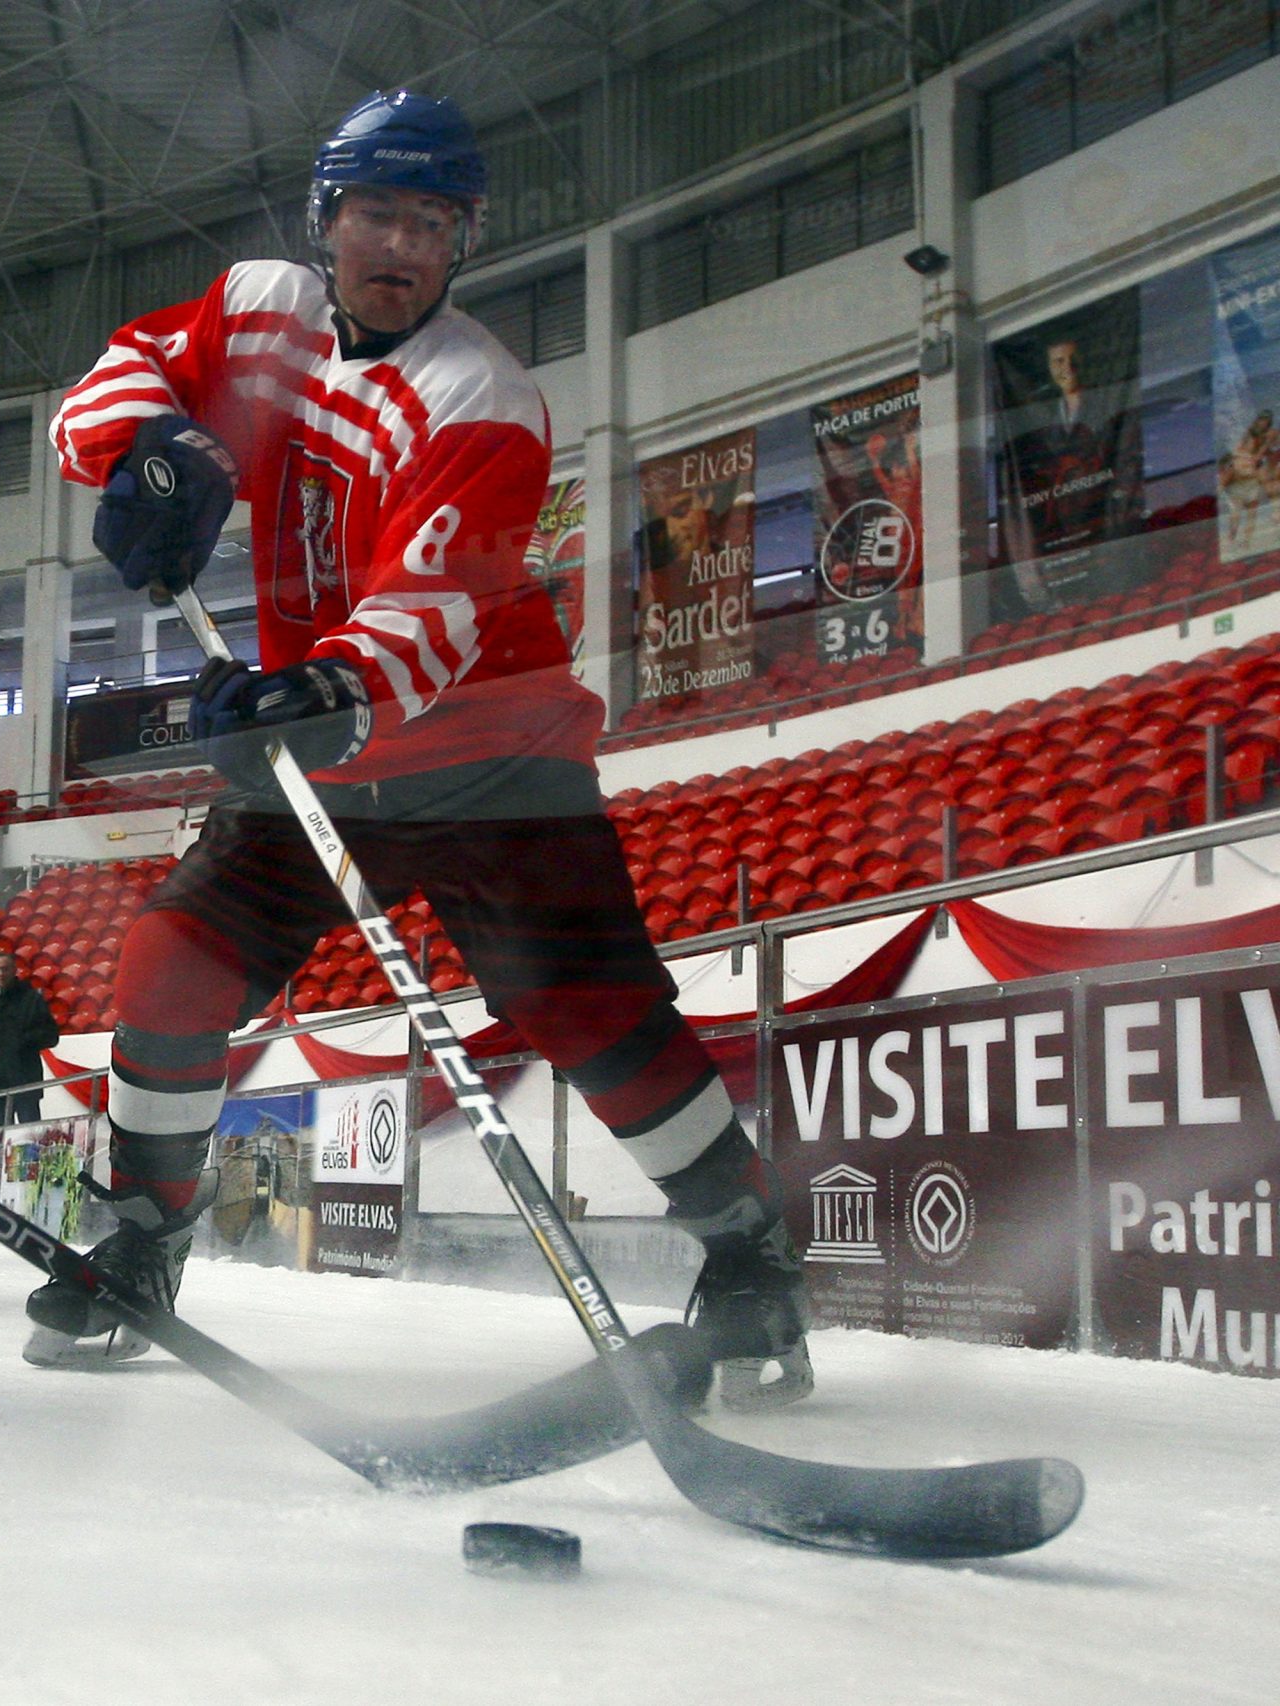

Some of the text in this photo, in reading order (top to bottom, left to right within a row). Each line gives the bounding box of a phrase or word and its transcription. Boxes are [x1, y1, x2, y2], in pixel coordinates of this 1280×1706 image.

[373, 149, 433, 163] BAUER
[852, 406, 871, 425] DE
[681, 442, 754, 489] Elvas
[1021, 489, 1051, 508] TONY
[403, 503, 462, 575] 8
[688, 536, 753, 587] André
[857, 516, 905, 567] FINAL 8
[644, 580, 753, 655] Sardet
[825, 608, 889, 652] 3 a 6
[640, 660, 752, 699] 23 de Dezembro
[307, 811, 338, 854] ONE.4
[358, 914, 516, 1140] BAUER
[783, 1010, 1069, 1142] VISITE
[321, 1202, 397, 1234] VISITE ELVAS,
[813, 1194, 875, 1241] UNESCO
[1108, 1180, 1273, 1257] Patri
[573, 1275, 626, 1352] ONE.4
[1160, 1286, 1280, 1370] Mu
[1001, 1333, 1025, 1346] 2012
